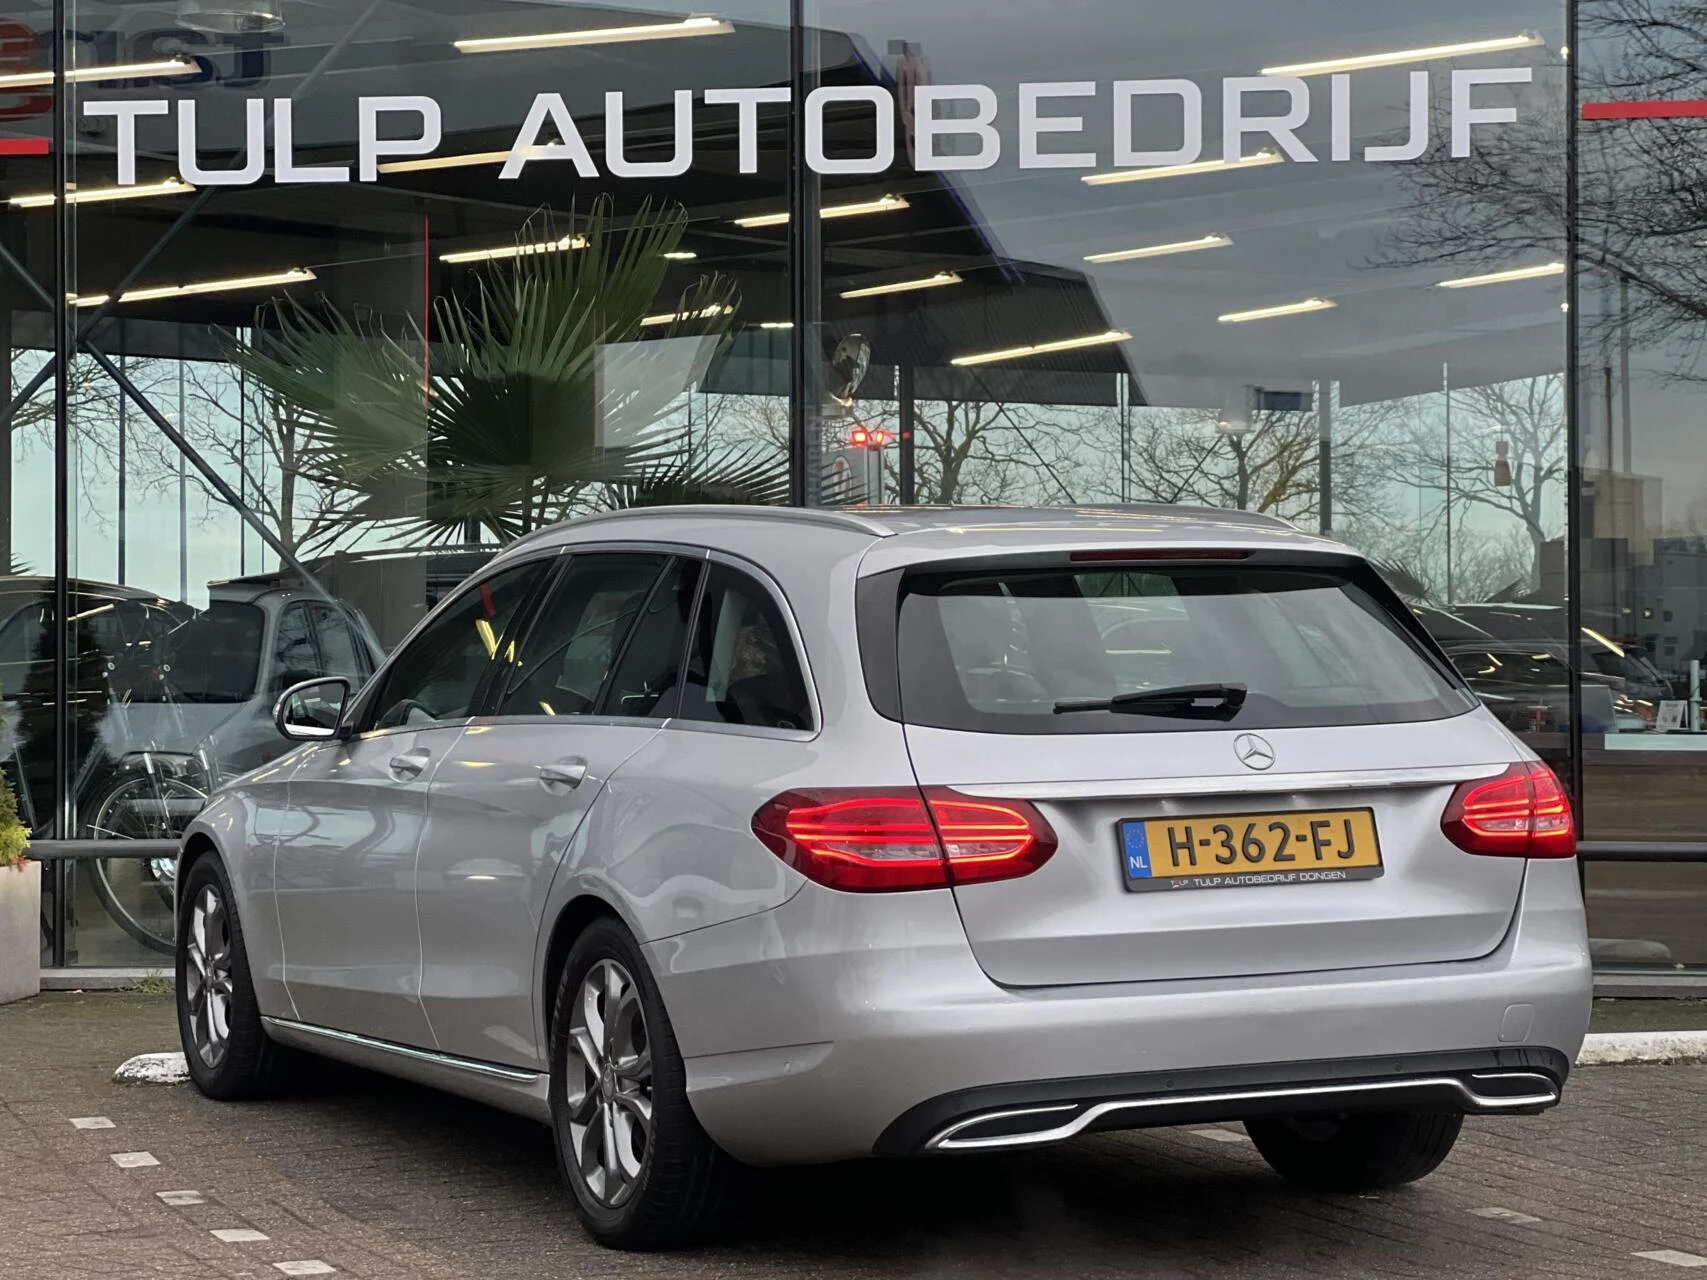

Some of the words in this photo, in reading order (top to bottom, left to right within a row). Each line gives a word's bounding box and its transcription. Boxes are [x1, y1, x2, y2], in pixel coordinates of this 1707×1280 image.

[83, 93, 442, 185] TULP
[498, 67, 1533, 180] AUTOBEDRIJF
[1167, 819, 1356, 867] H-362-FJ
[1130, 855, 1148, 869] NL
[1193, 877, 1221, 887] TULP
[1224, 872, 1296, 885] AUTOBEDRIJF
[1299, 871, 1346, 881] DONGEN
